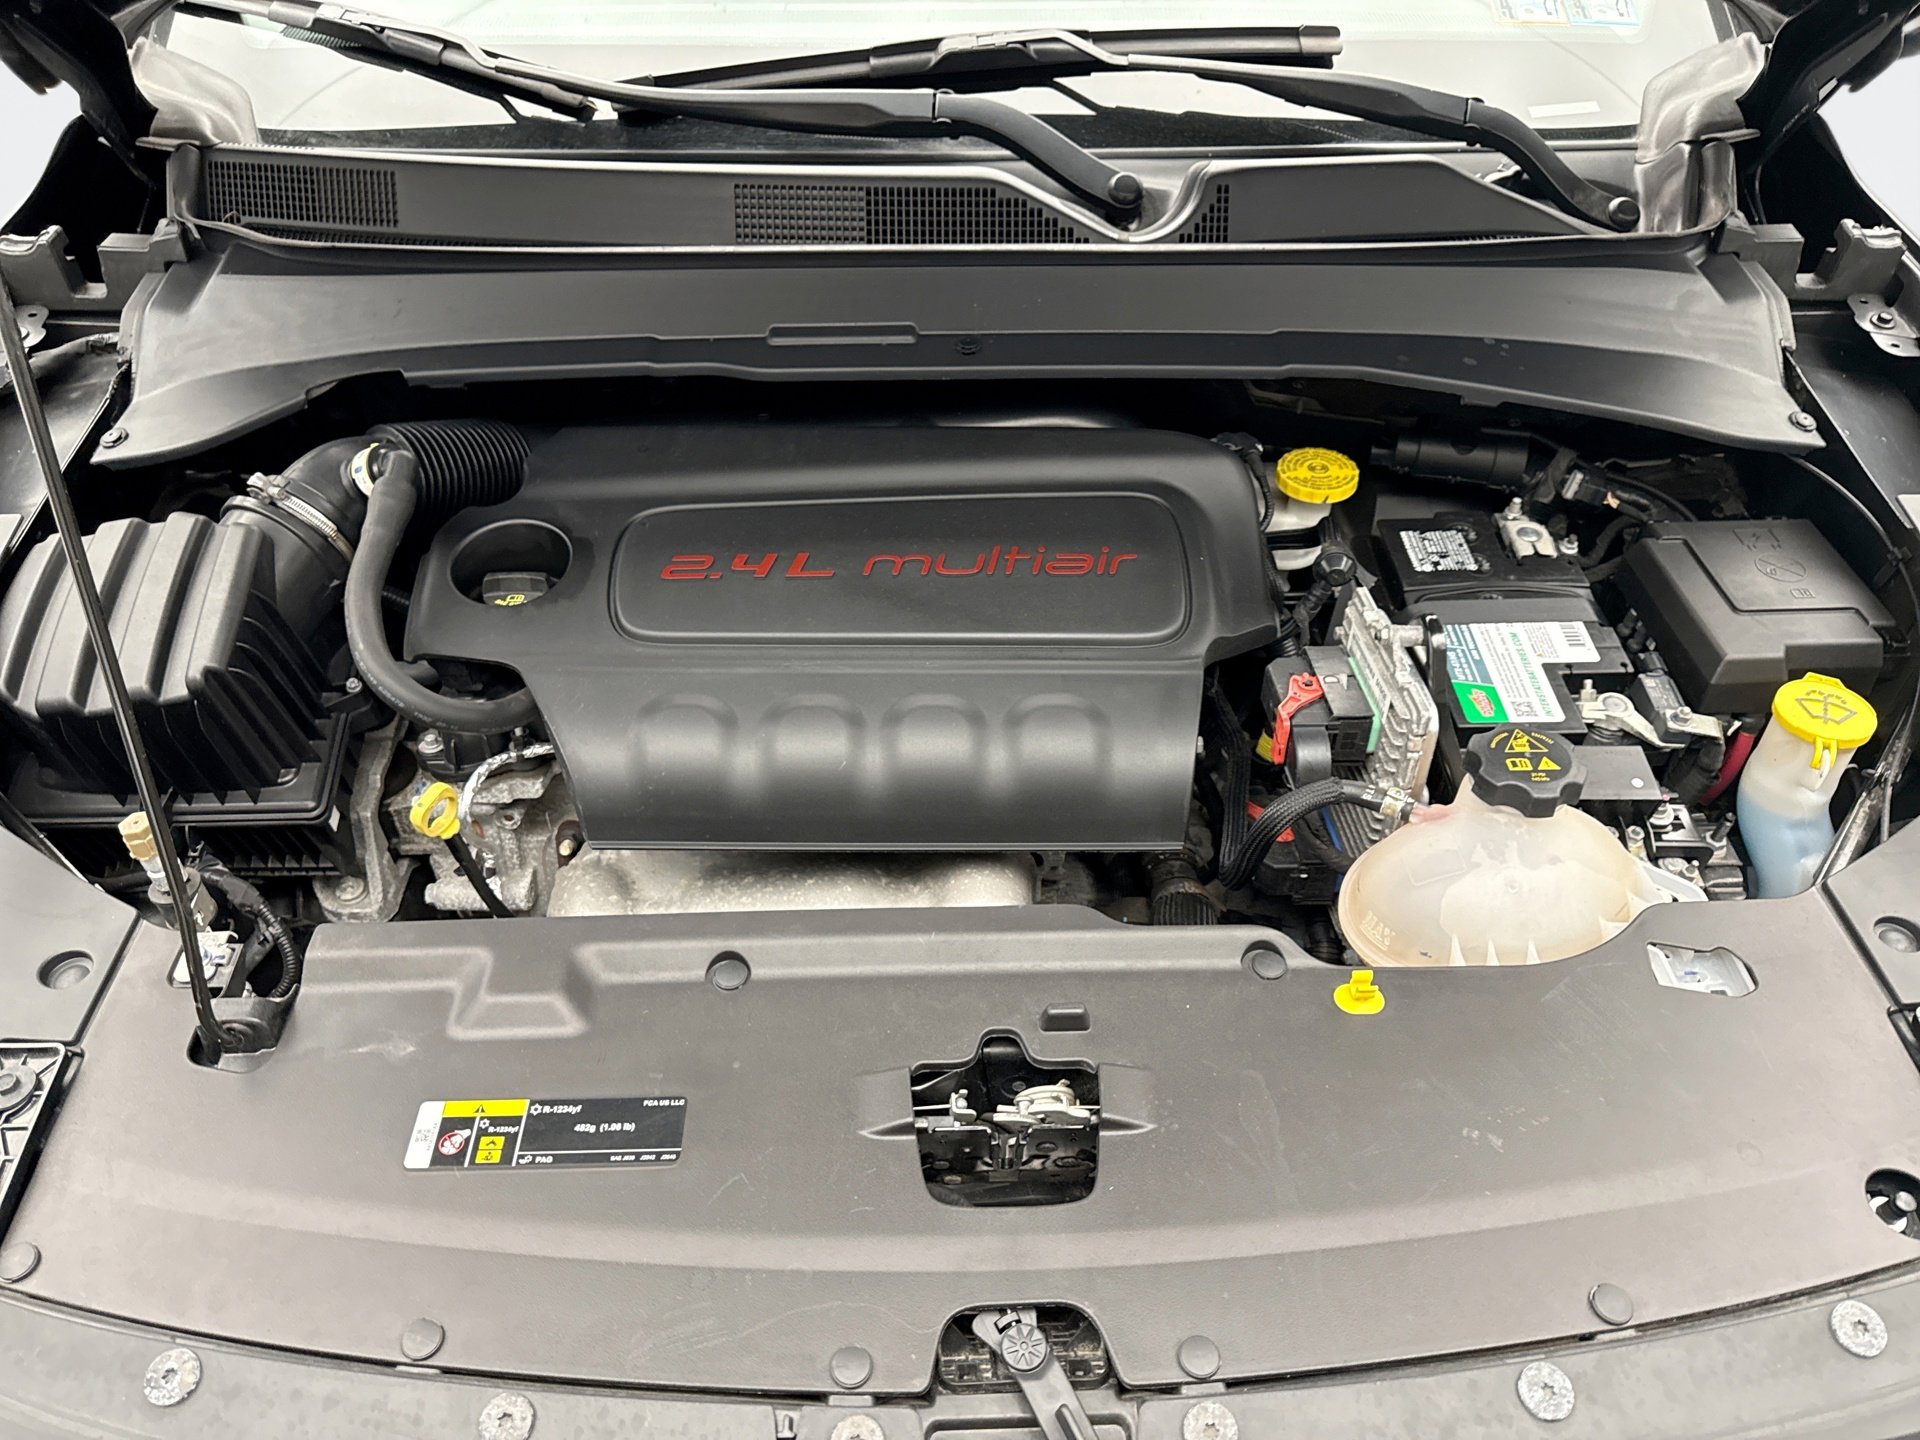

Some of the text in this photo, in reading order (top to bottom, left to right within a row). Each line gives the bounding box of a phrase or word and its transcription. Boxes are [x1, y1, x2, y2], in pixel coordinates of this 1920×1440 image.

[660, 545, 1137, 580] 2.4L multiair
[1509, 632, 1554, 717] INTERSTATEBATTERIES.COM
[643, 1099, 659, 1107] FCA
[542, 1104, 583, 1115] R-1234yf
[488, 1125, 520, 1134] R-1234yf
[622, 1122, 636, 1132] lb)
[535, 1155, 553, 1163] PAG
